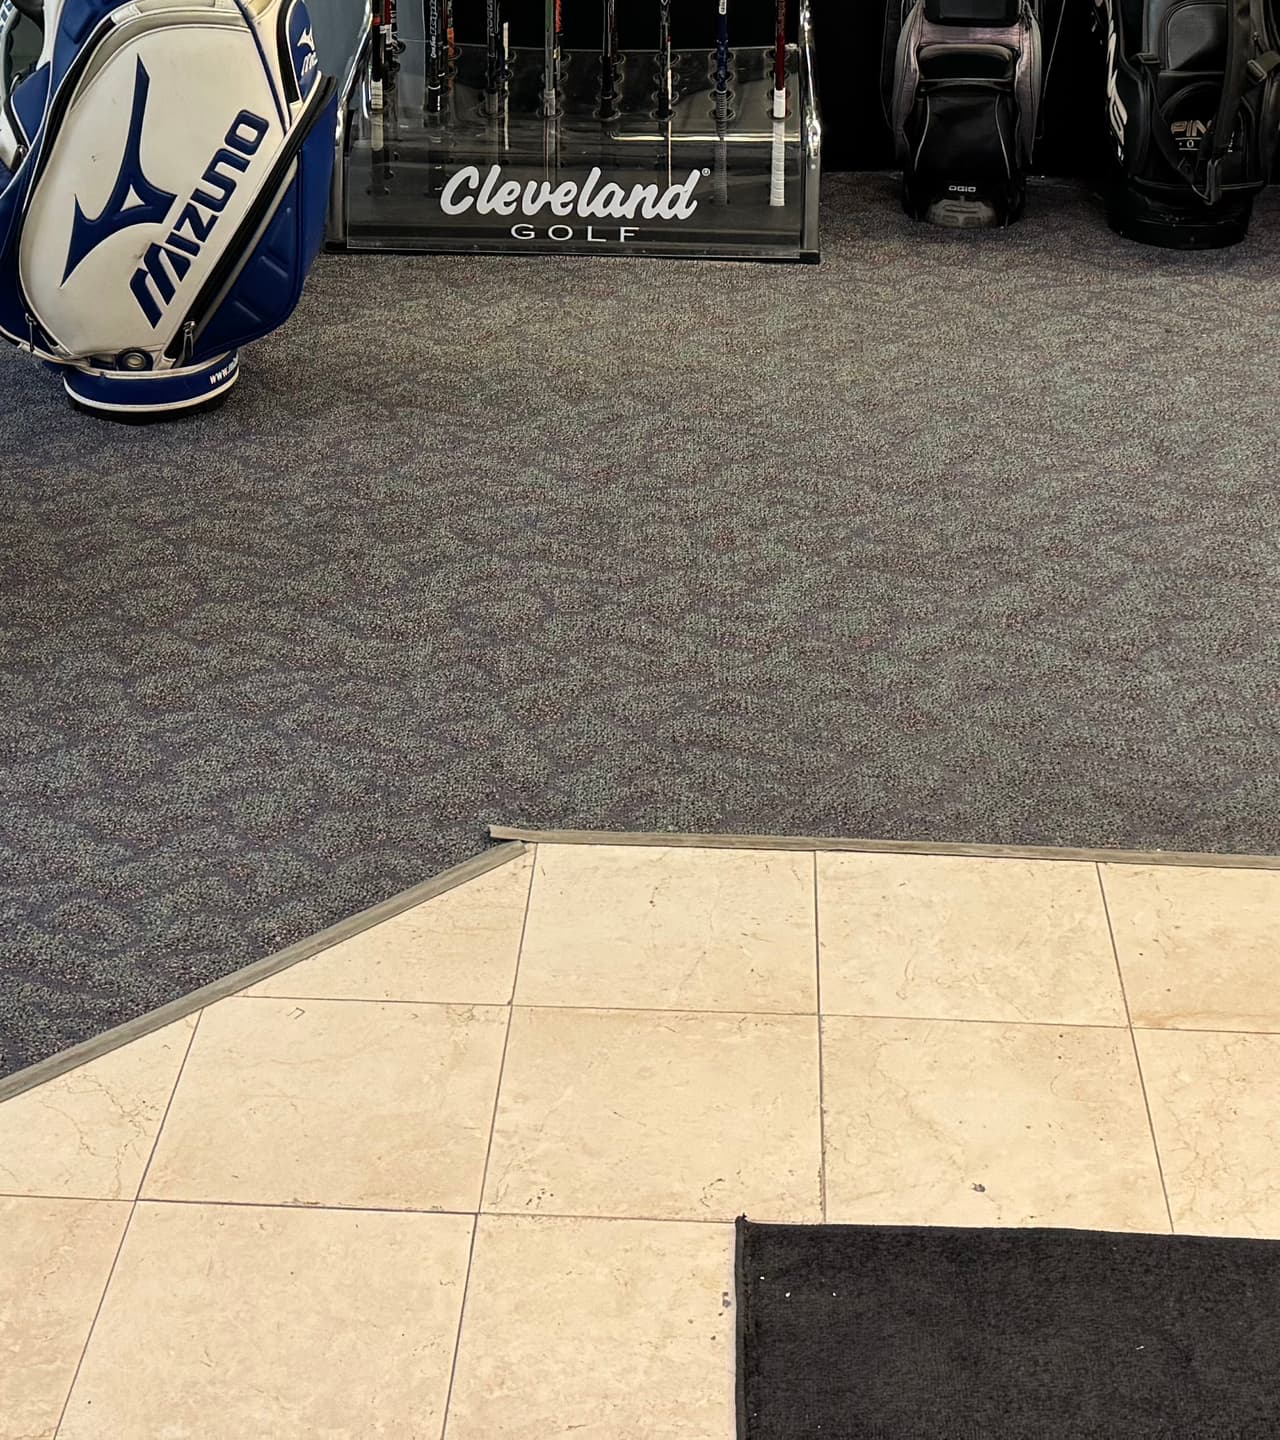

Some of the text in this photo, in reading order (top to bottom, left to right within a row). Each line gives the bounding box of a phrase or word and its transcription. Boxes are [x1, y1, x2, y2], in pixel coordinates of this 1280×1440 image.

[1170, 119, 1213, 137] PIN
[439, 163, 701, 221] Cleveland
[129, 109, 269, 330] MIZUNO
[510, 223, 641, 243] GOLF
